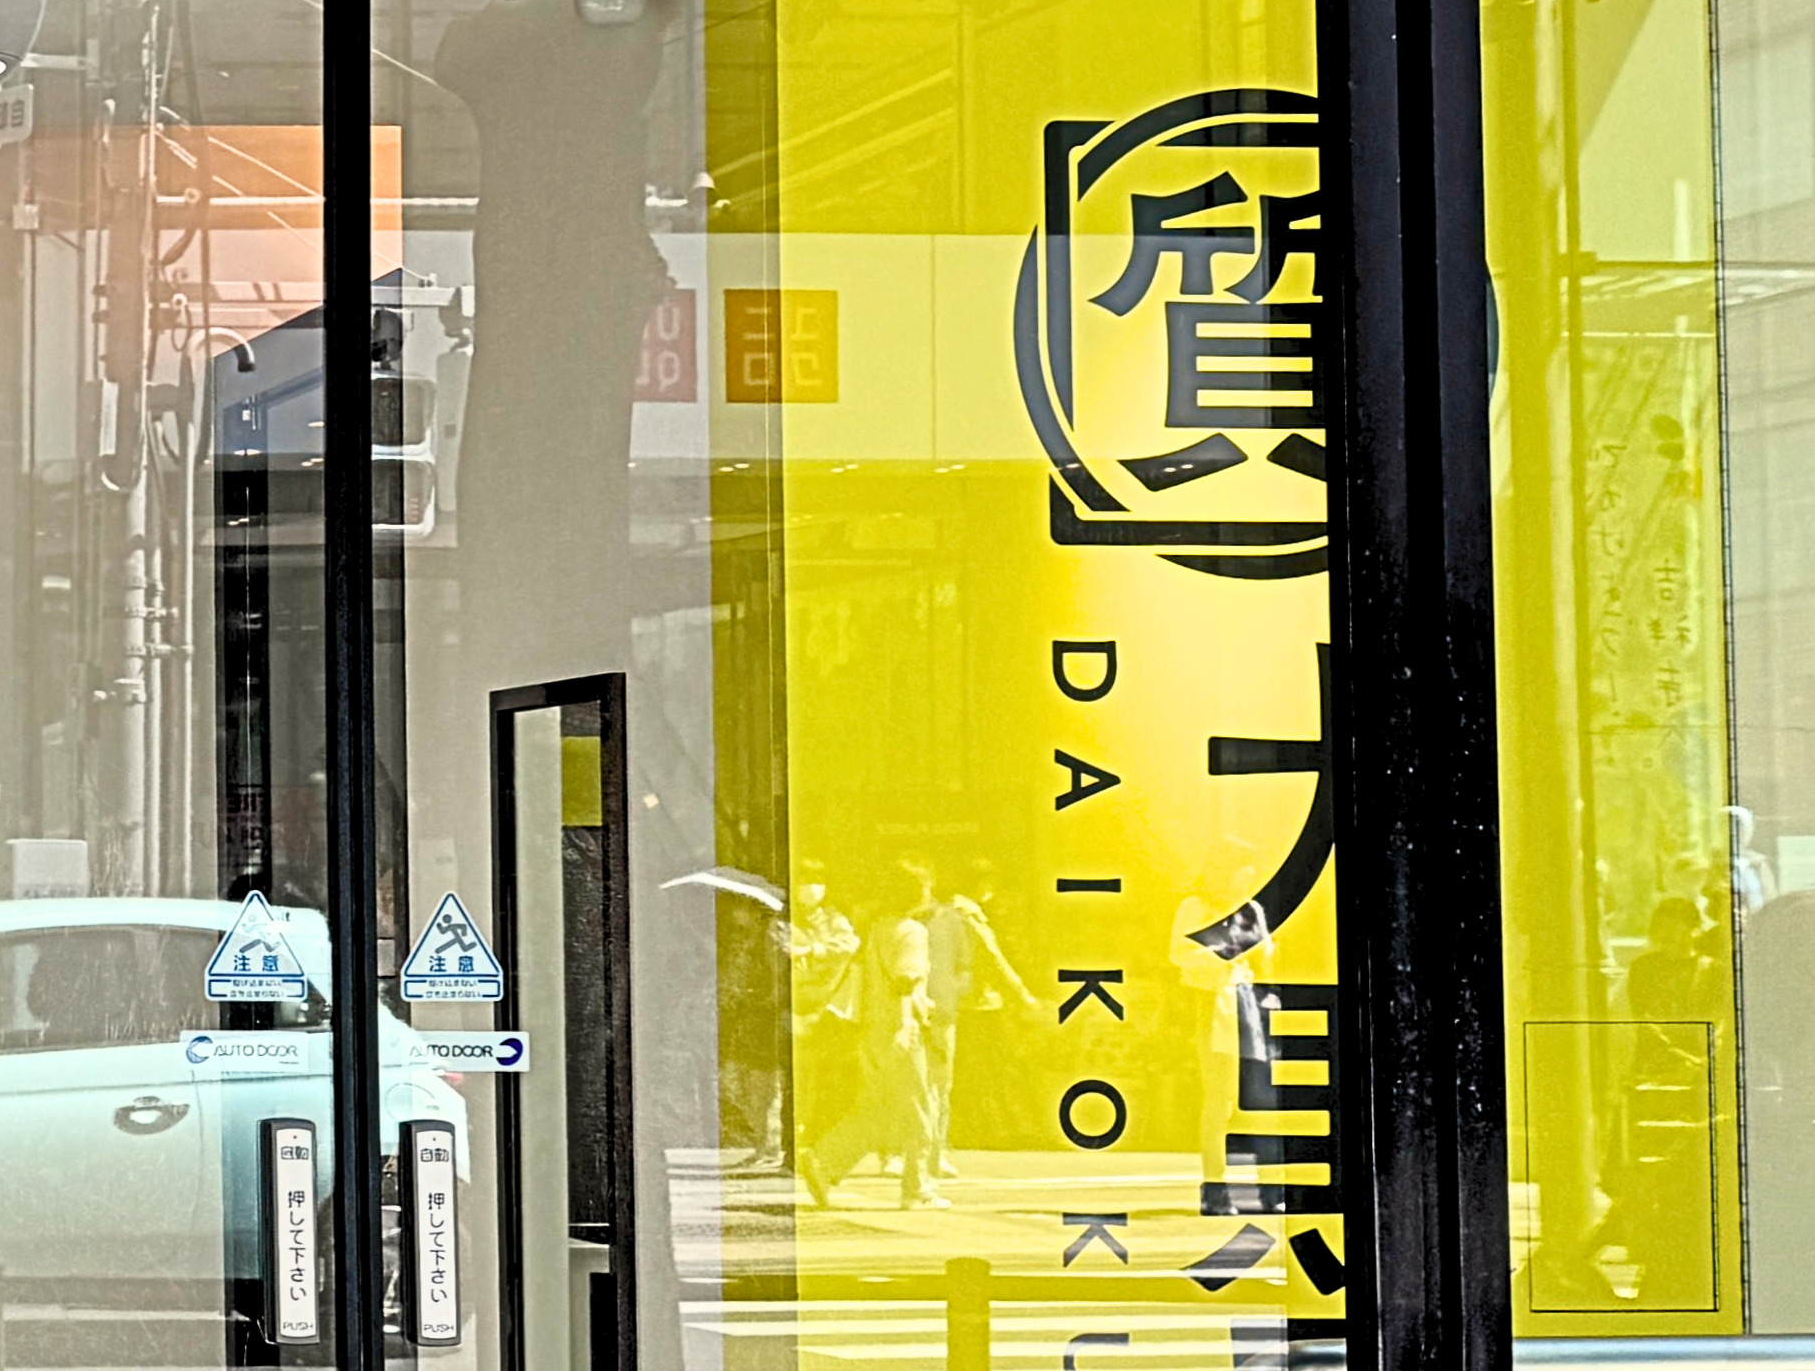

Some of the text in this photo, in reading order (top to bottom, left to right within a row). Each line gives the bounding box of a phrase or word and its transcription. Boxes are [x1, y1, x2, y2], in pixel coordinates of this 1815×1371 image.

[429, 955, 475, 973] 注意
[213, 1044, 298, 1058] AUTO DOOR
[452, 1044, 493, 1058] DOOR
[420, 1147, 449, 1163] 自動
[288, 1190, 307, 1302] 押して下さい
[428, 1192, 448, 1303] 押して下さい
[283, 1321, 314, 1332] PUSH
[423, 1323, 454, 1334] PUSH
